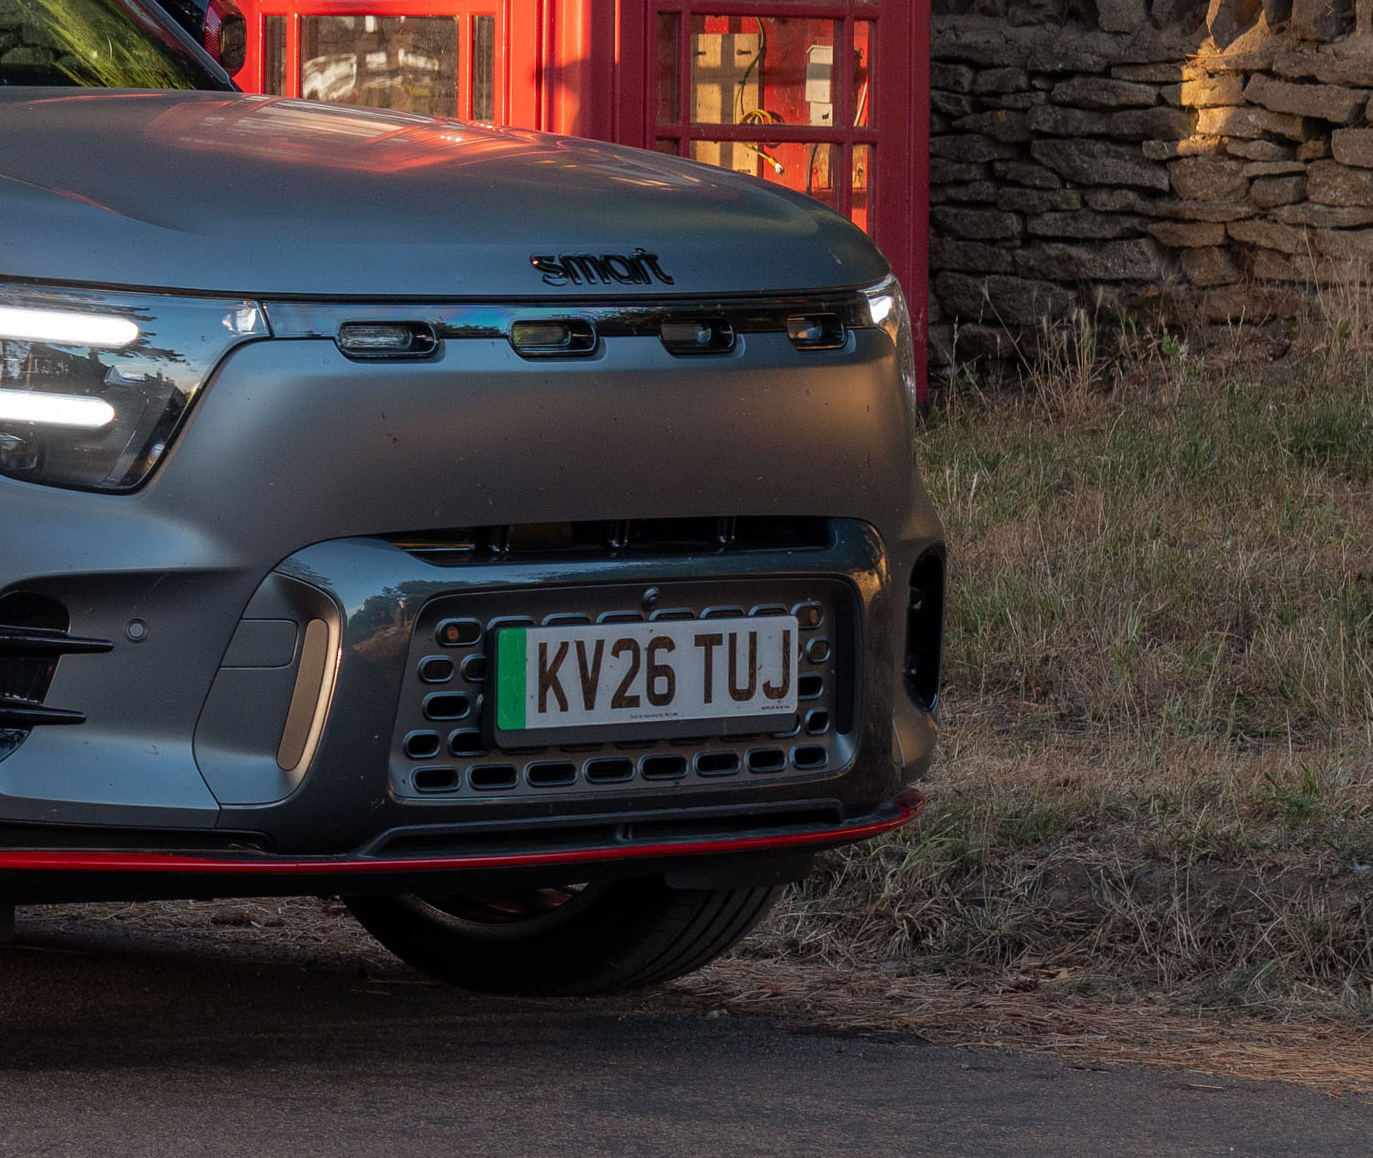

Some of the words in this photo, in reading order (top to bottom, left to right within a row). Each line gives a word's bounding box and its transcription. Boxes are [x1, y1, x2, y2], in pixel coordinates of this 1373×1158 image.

[530, 247, 675, 287] smart
[537, 636, 676, 714] KV26
[694, 630, 791, 704] TUJ
